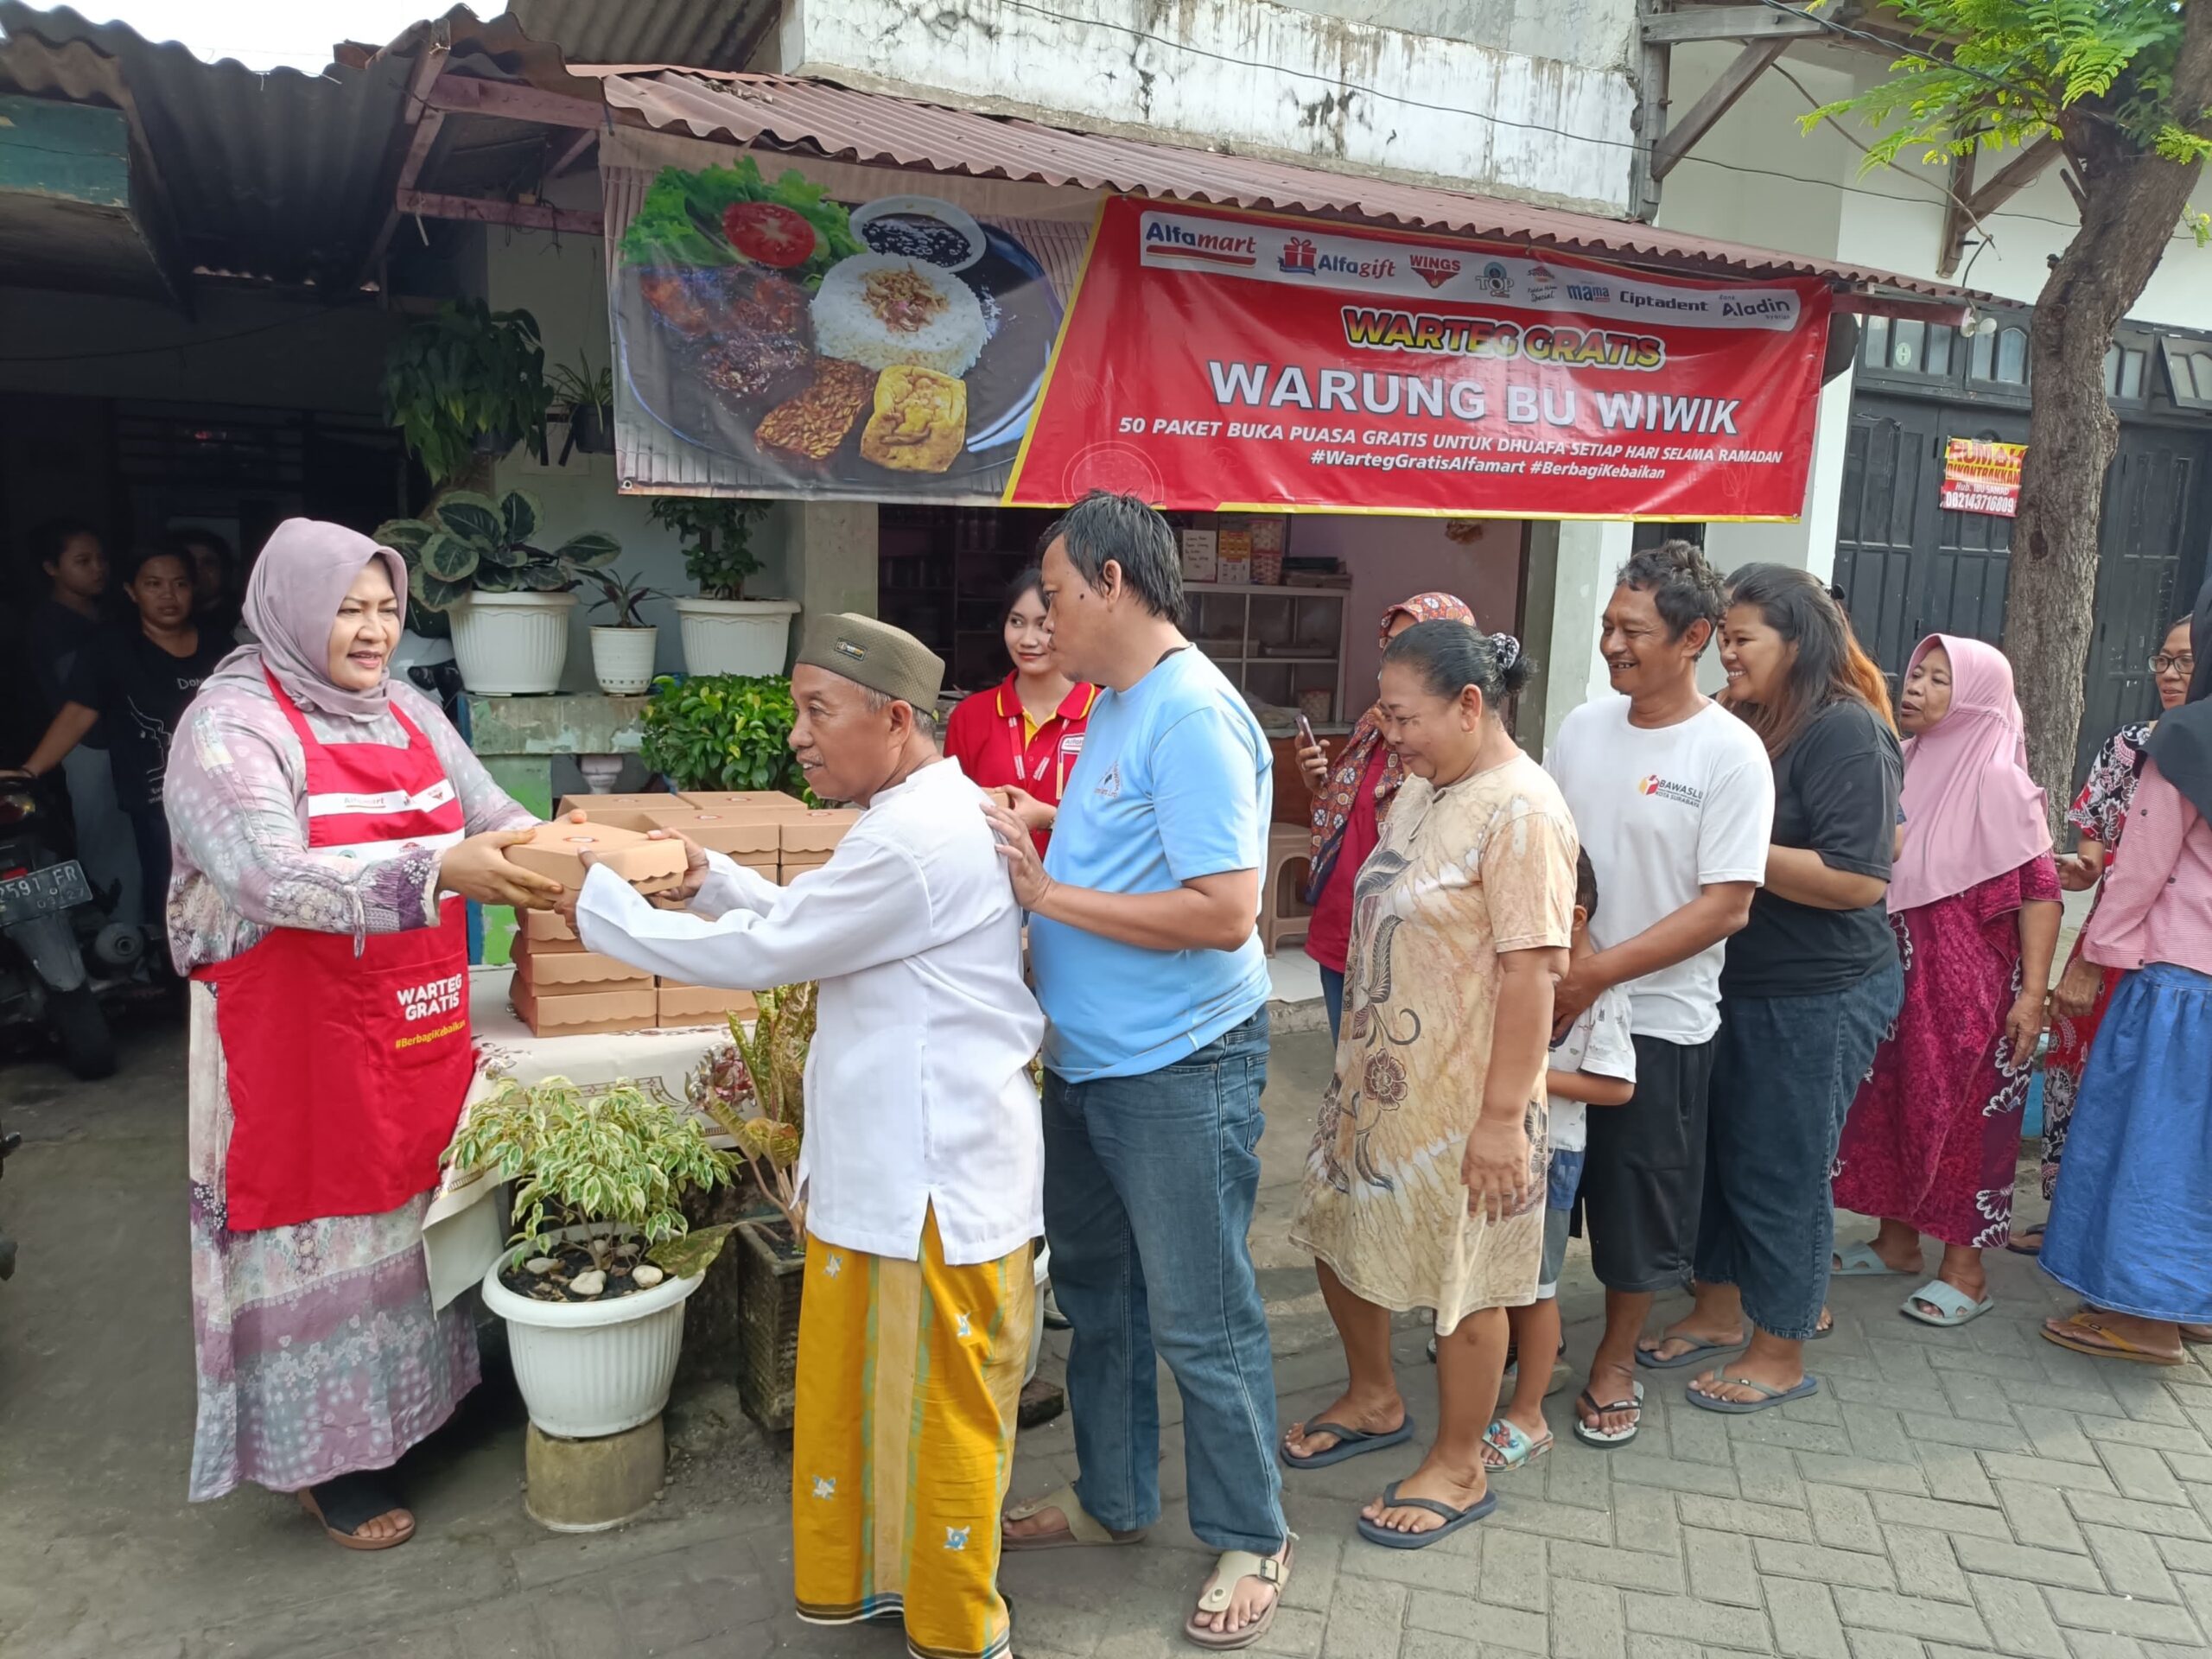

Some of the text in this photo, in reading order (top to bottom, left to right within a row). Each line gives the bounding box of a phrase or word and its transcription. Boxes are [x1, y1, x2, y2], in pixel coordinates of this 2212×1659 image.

[1146, 222, 1256, 254] Alfamart
[1318, 254, 1395, 280] Alfagift
[1409, 254, 1461, 272] WINGS
[1475, 275, 1514, 292] TOP
[1567, 284, 1610, 302] mama
[1619, 290, 1709, 312] Ciptadent
[1722, 298, 1790, 316] Aladin
[1342, 308, 1663, 369] WARTEG GRATIS
[1209, 360, 1741, 435] WARUNG BU WIWIK
[1119, 416, 1783, 464] 50 PAKET BUKA PUASA GRATIS UNTUK DHUAFA SETIAP HARI SELAMA RAMADAN
[1311, 449, 1666, 480] #WartegGratisAlfamart #BerbagiKebaikan
[1949, 440, 2025, 468] RUMAH
[1659, 779, 1703, 800] BAWASLU
[52, 866, 78, 886] FR
[397, 973, 462, 1006] WARTEG
[405, 991, 460, 1021] GRATIS
